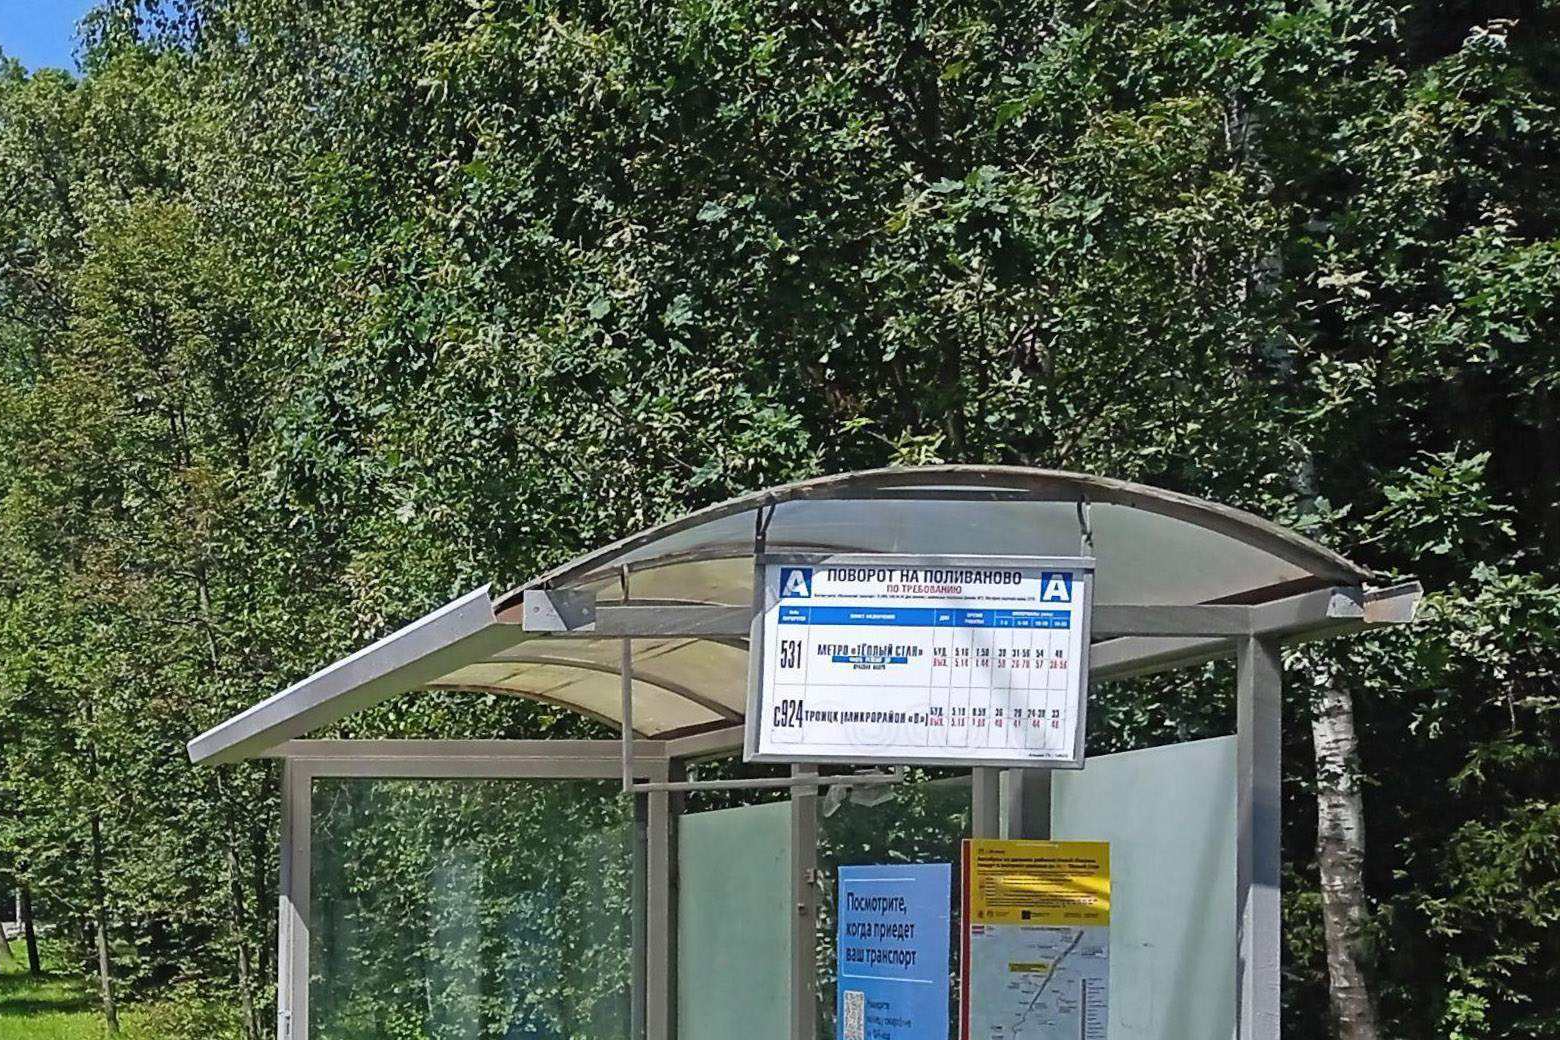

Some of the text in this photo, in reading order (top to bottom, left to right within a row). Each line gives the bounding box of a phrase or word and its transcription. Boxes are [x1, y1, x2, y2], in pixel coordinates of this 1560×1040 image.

[827, 568, 1022, 585] ПОВОРОТ НА ПОЛИВАНОВО
[886, 584, 962, 595] ПО ТРЕБОВАНИЮ
[1042, 574, 1070, 601] А
[780, 640, 802, 669] 531
[817, 644, 849, 656] МЕТРО
[805, 710, 838, 723] ТРОИЦК
[846, 892, 907, 916] Посмотрите,
[846, 922, 915, 942] когда приедет
[846, 947, 916, 970] ваш транспорт
